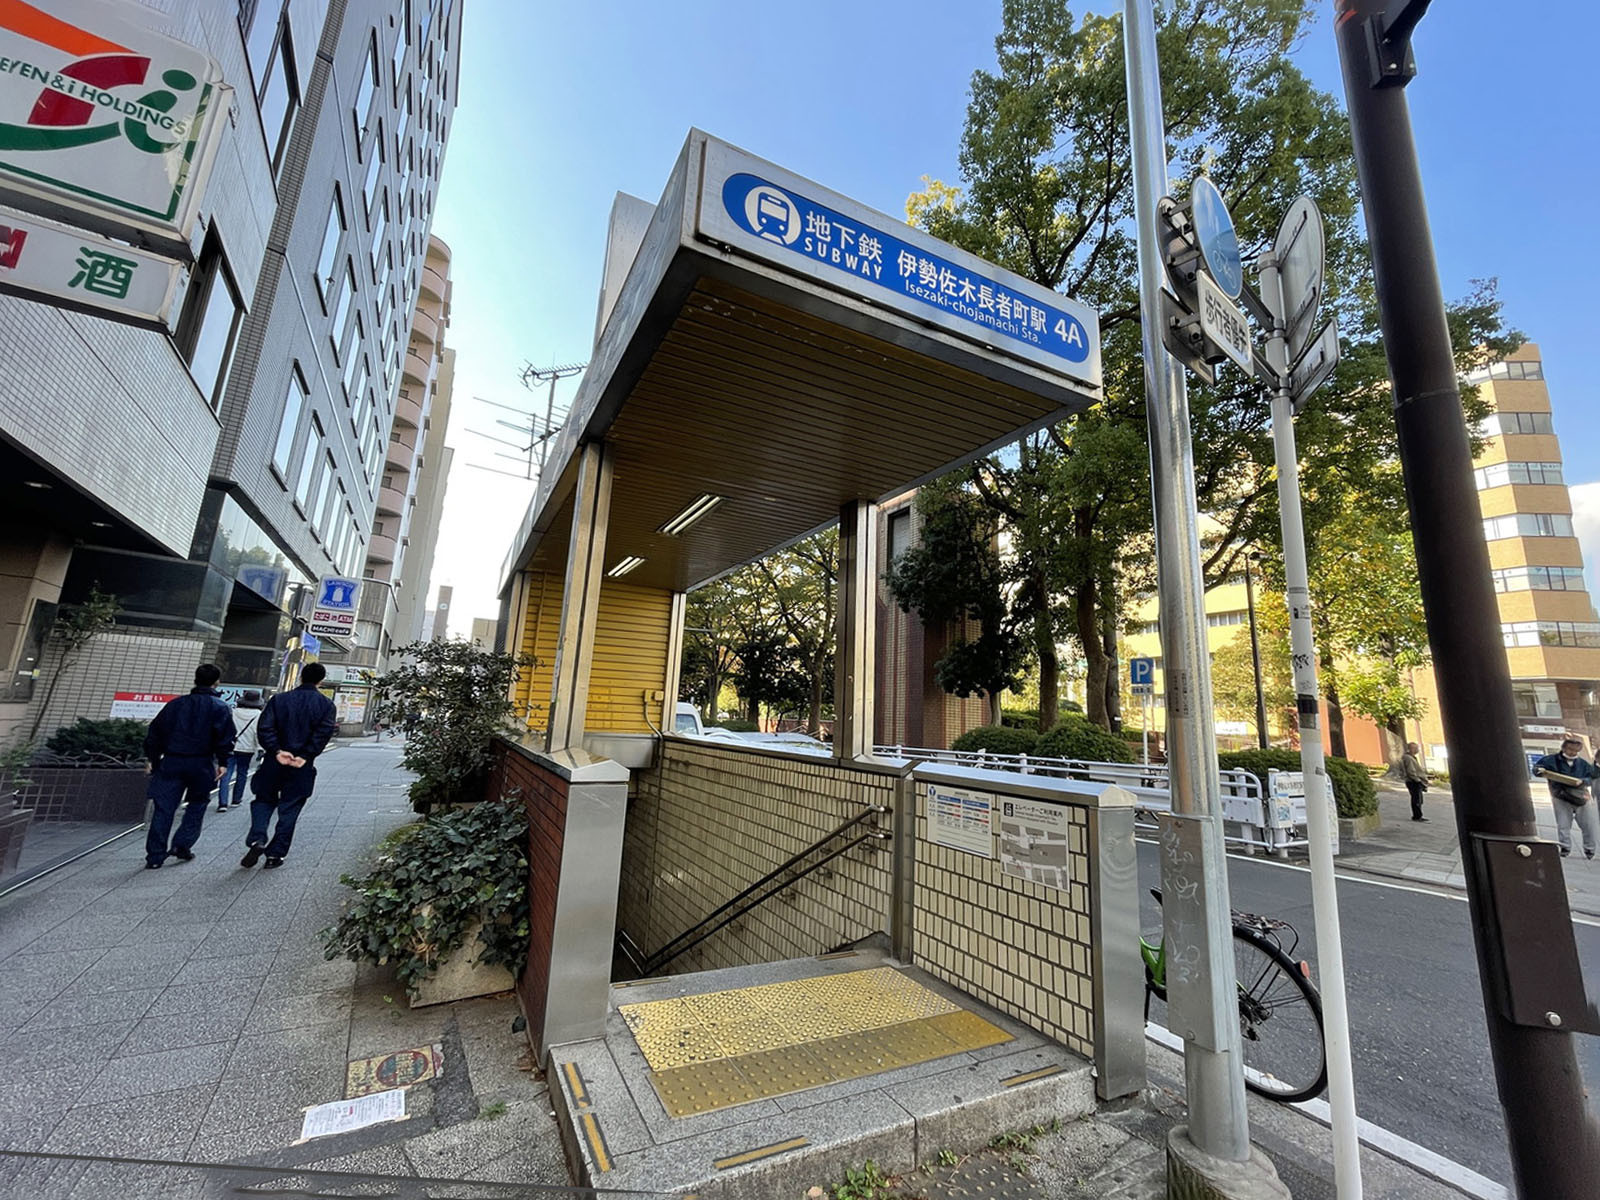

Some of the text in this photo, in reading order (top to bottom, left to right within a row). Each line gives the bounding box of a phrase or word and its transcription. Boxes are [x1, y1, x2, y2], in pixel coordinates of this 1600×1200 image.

[80, 86, 187, 136] HOLDINGS
[68, 246, 139, 299] 酒
[804, 237, 883, 280] SUBWAY
[805, 210, 1083, 349] 地下鉄 伊勢佐木長者町駅 4A
[905, 279, 1041, 344] Isezaki-chojamachi Sta.
[1136, 660, 1150, 682] P
